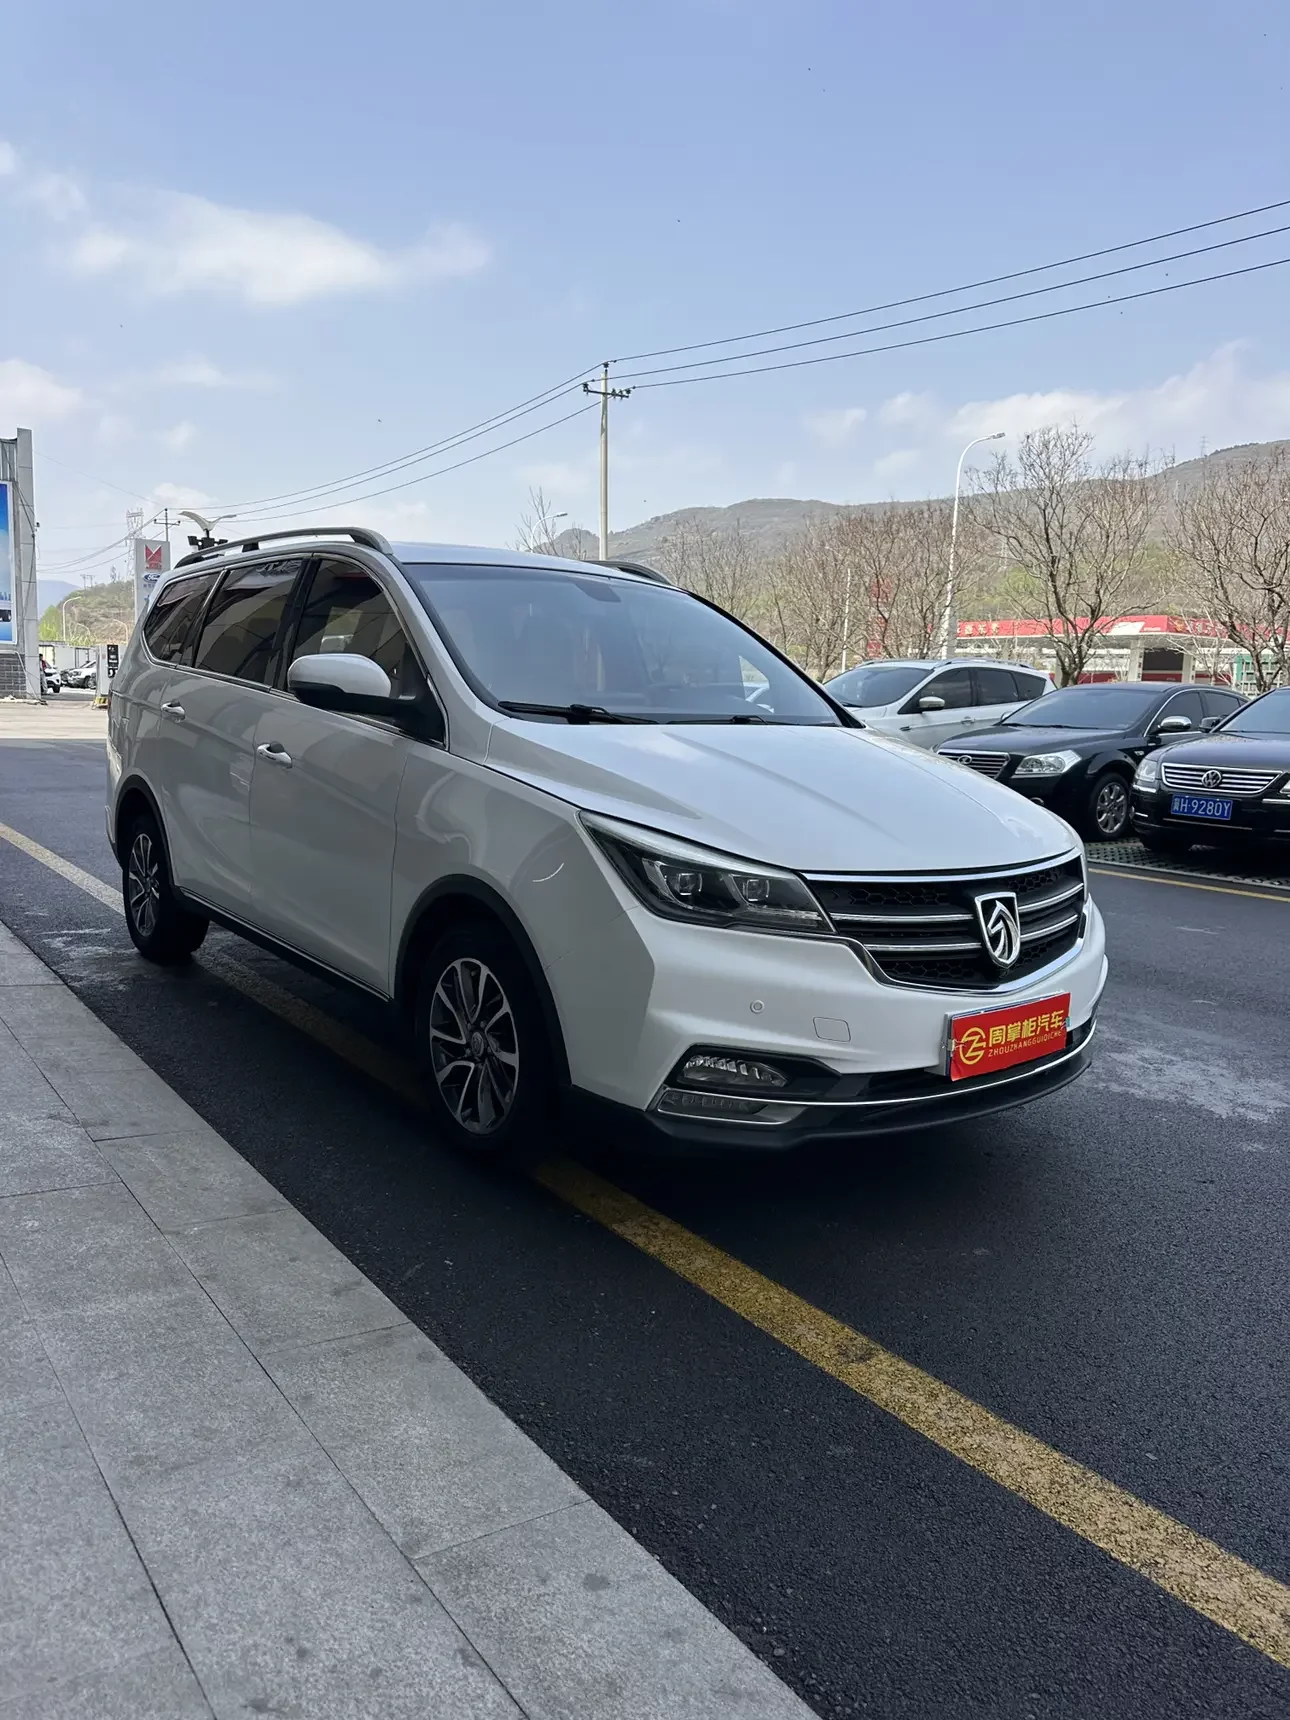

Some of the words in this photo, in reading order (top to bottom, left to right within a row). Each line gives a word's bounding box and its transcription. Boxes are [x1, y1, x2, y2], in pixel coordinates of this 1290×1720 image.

[988, 1031, 1062, 1057] ZHOUZHANGGUIQICHE
[989, 1010, 1064, 1047] 周掌柜汽车
